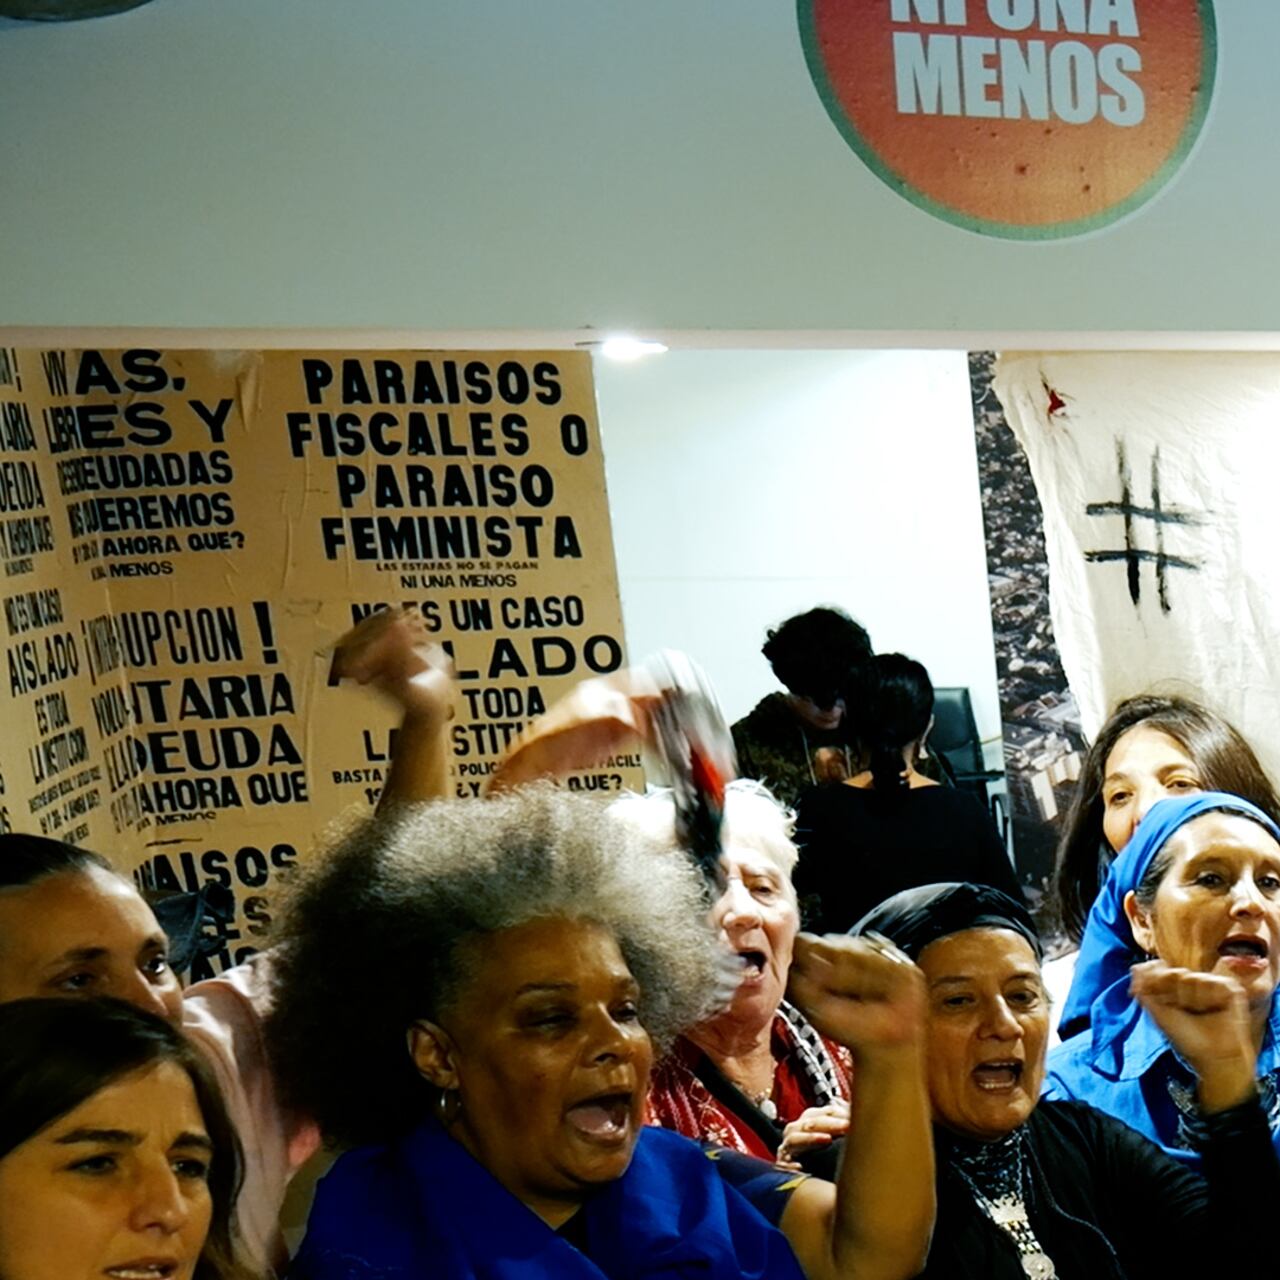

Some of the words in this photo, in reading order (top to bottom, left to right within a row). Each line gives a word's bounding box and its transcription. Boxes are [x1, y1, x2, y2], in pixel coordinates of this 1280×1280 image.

[892, 31, 1146, 128] MENOS
[303, 357, 562, 406] PARAISOS
[188, 398, 234, 443] Y
[286, 409, 531, 458] FISCALES
[560, 413, 590, 454] O
[337, 462, 555, 509] PARAISO
[102, 535, 182, 558] AHORA
[188, 530, 246, 552] QUE?
[321, 514, 583, 561] FEMINISTA
[109, 560, 174, 578] MENOS
[376, 562, 398, 572] LAS
[401, 575, 419, 589] NI
[422, 575, 455, 588] UNA
[460, 574, 517, 588] MENOS
[402, 600, 442, 632] S
[449, 598, 493, 631] UN
[502, 595, 585, 630] CASO
[7, 631, 79, 698] AISLADO
[463, 685, 546, 720] TODA
[333, 769, 382, 785] BASTA
[567, 774, 622, 793] QUE?
